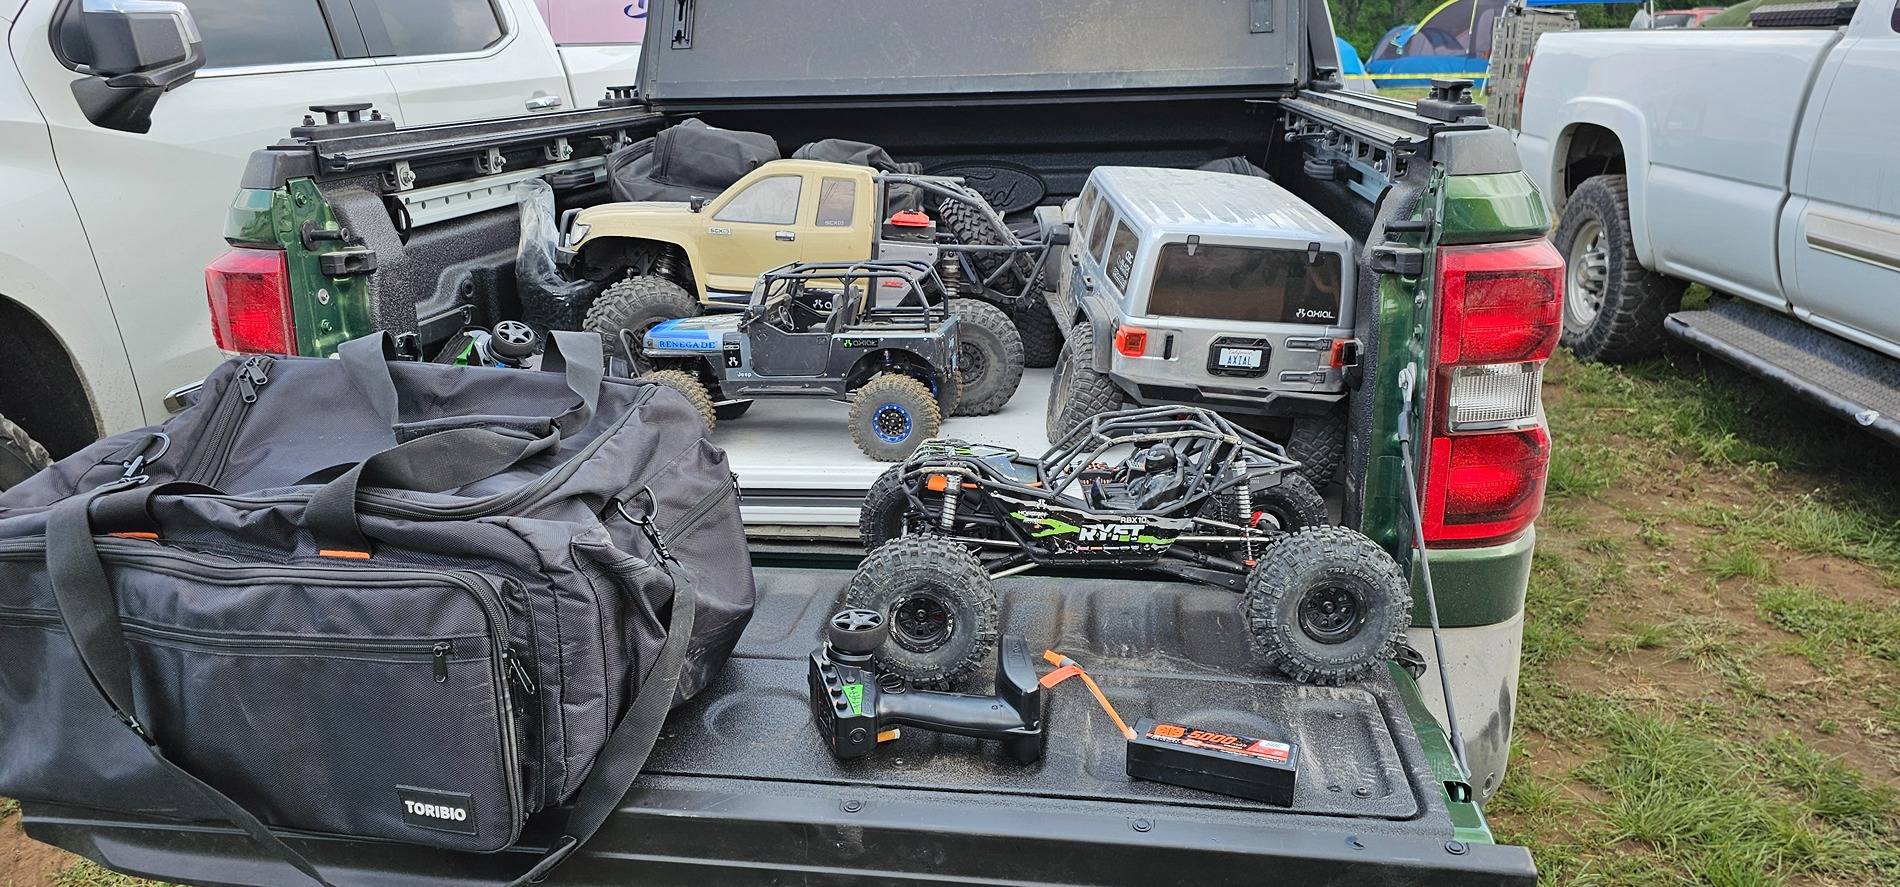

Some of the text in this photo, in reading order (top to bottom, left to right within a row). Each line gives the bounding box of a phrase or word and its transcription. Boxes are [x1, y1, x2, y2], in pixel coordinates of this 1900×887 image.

[659, 340, 716, 349] RENEGADE
[1226, 355, 1252, 367] AXIAL
[737, 371, 752, 379] Jeep
[1120, 516, 1148, 524] RBX10
[1079, 523, 1146, 542] RYFT
[1188, 730, 1238, 745] 5000
[404, 800, 467, 821] TORIBIO
